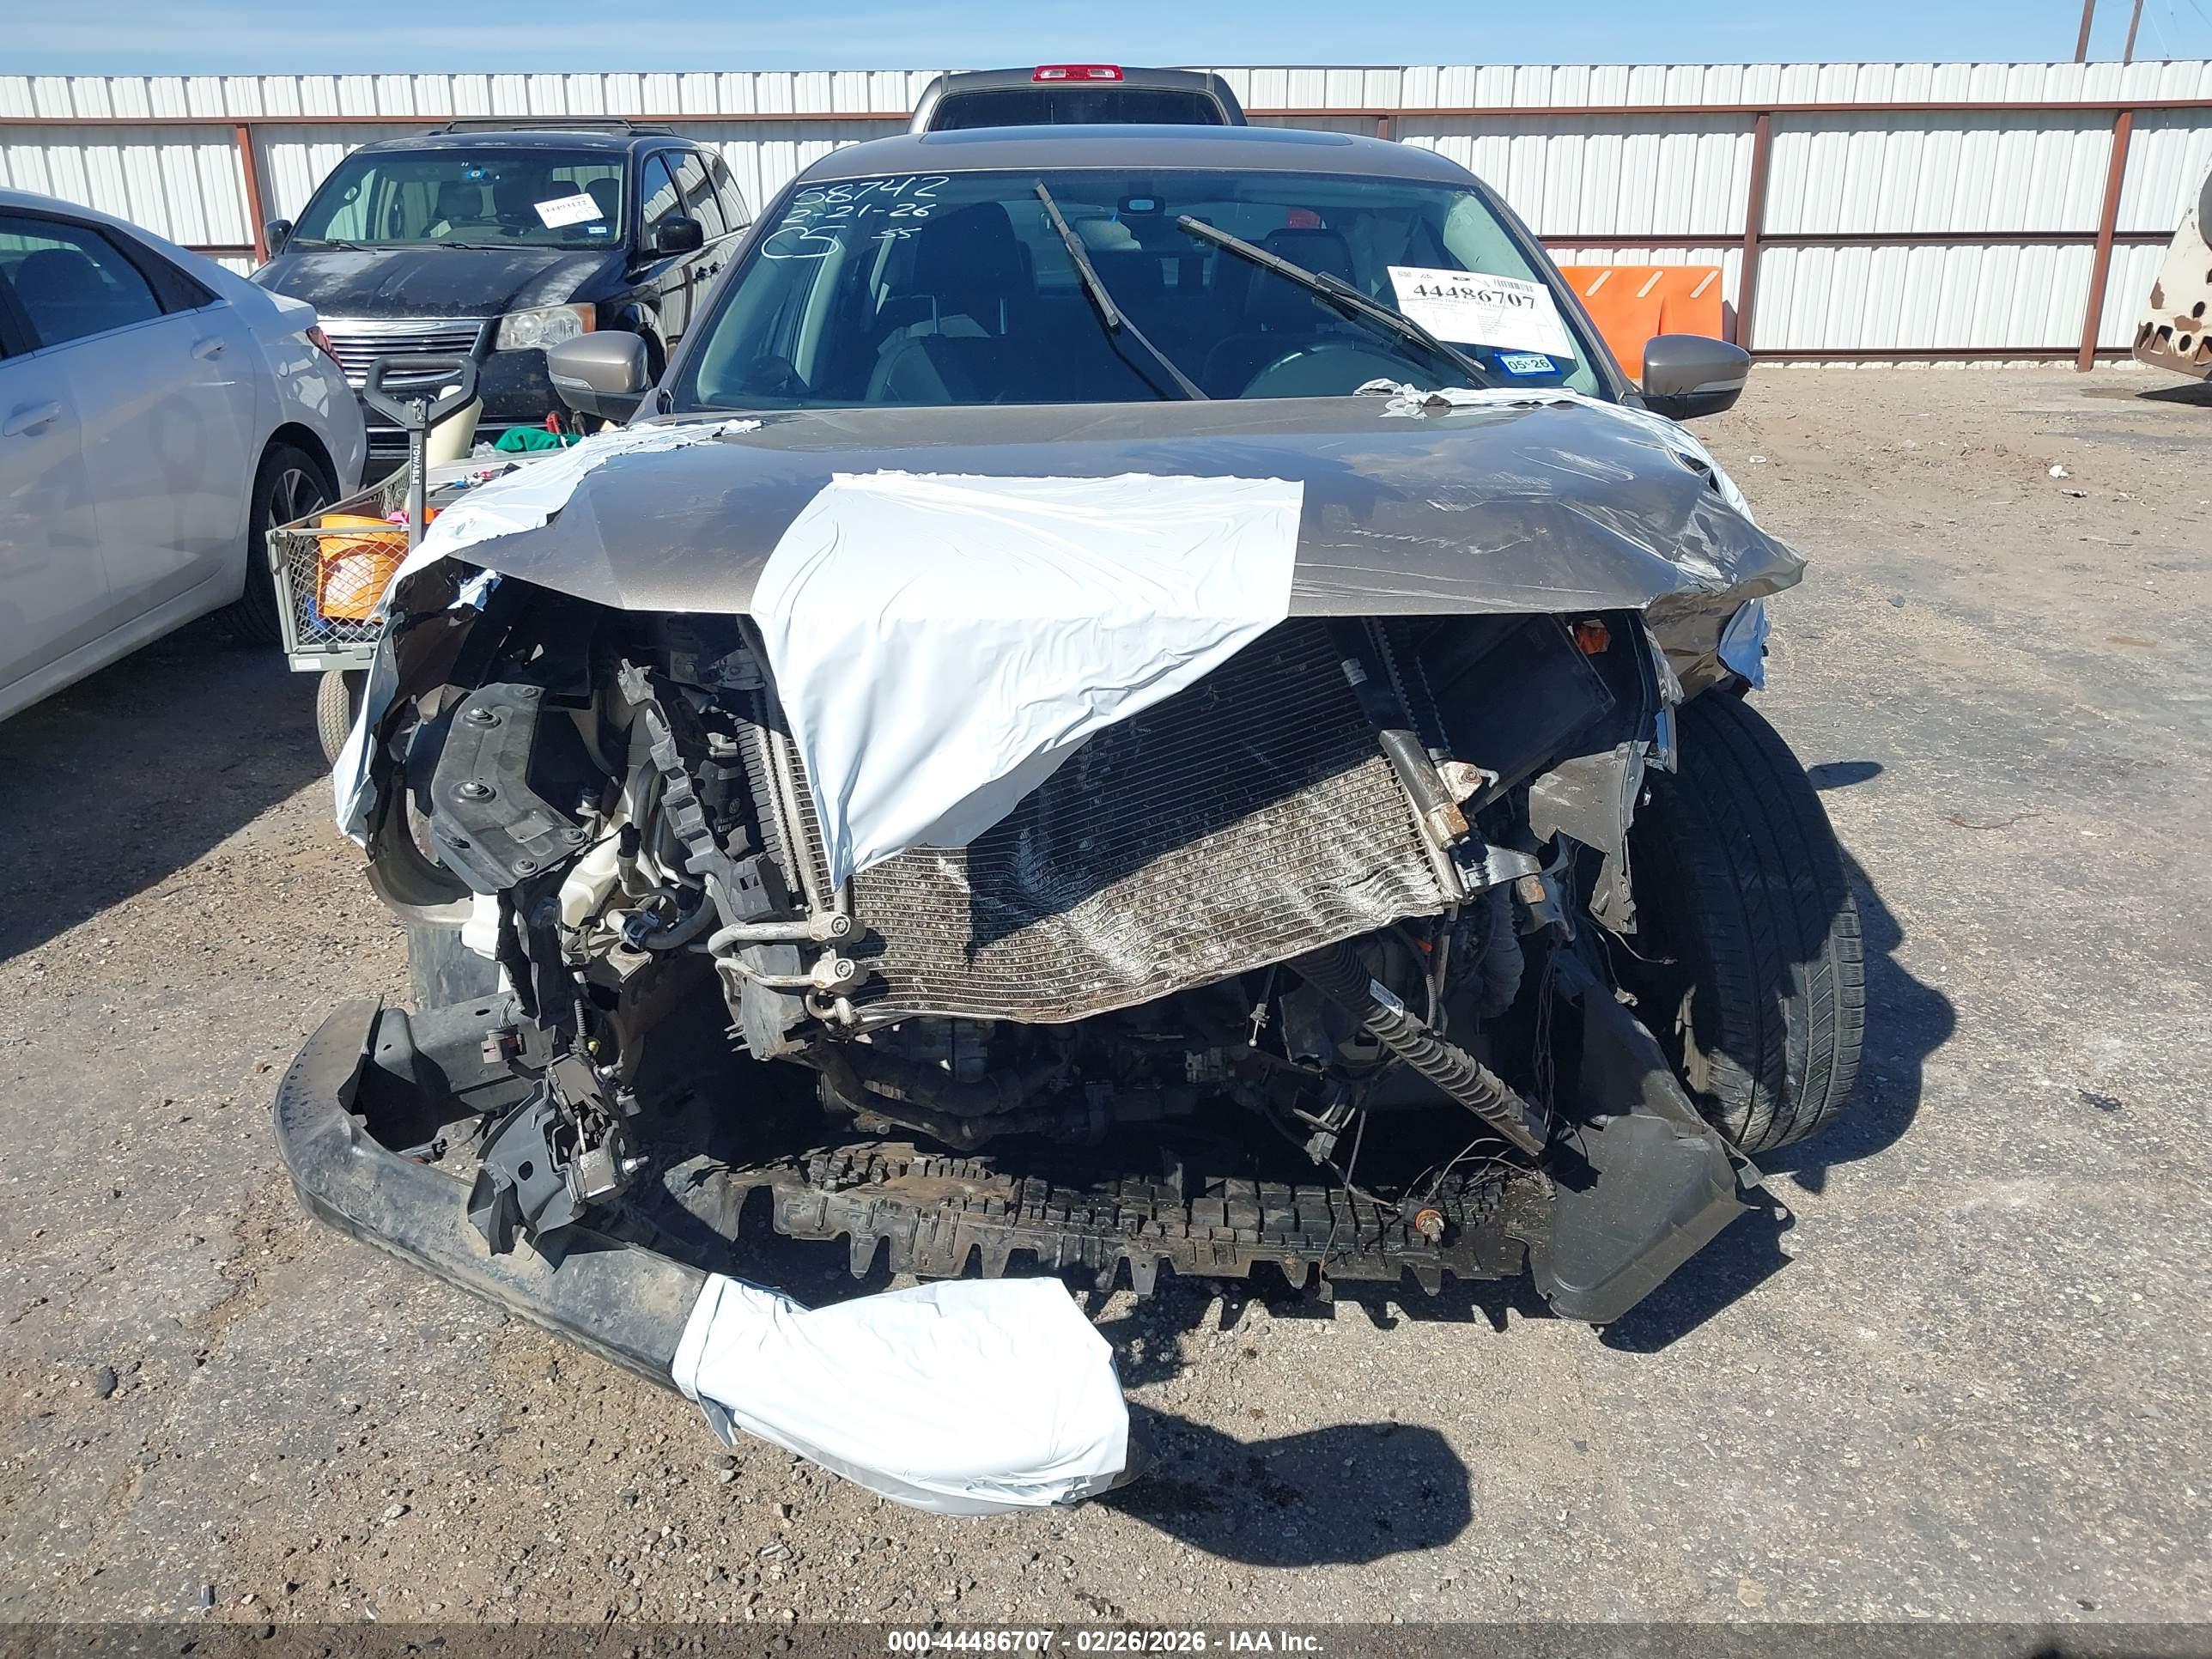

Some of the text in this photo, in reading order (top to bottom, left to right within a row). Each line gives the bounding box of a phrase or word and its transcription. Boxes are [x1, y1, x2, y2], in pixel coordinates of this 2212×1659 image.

[793, 177, 950, 205] 58742
[1413, 283, 1535, 310] 44486707
[411, 443, 421, 485] TOWABLE
